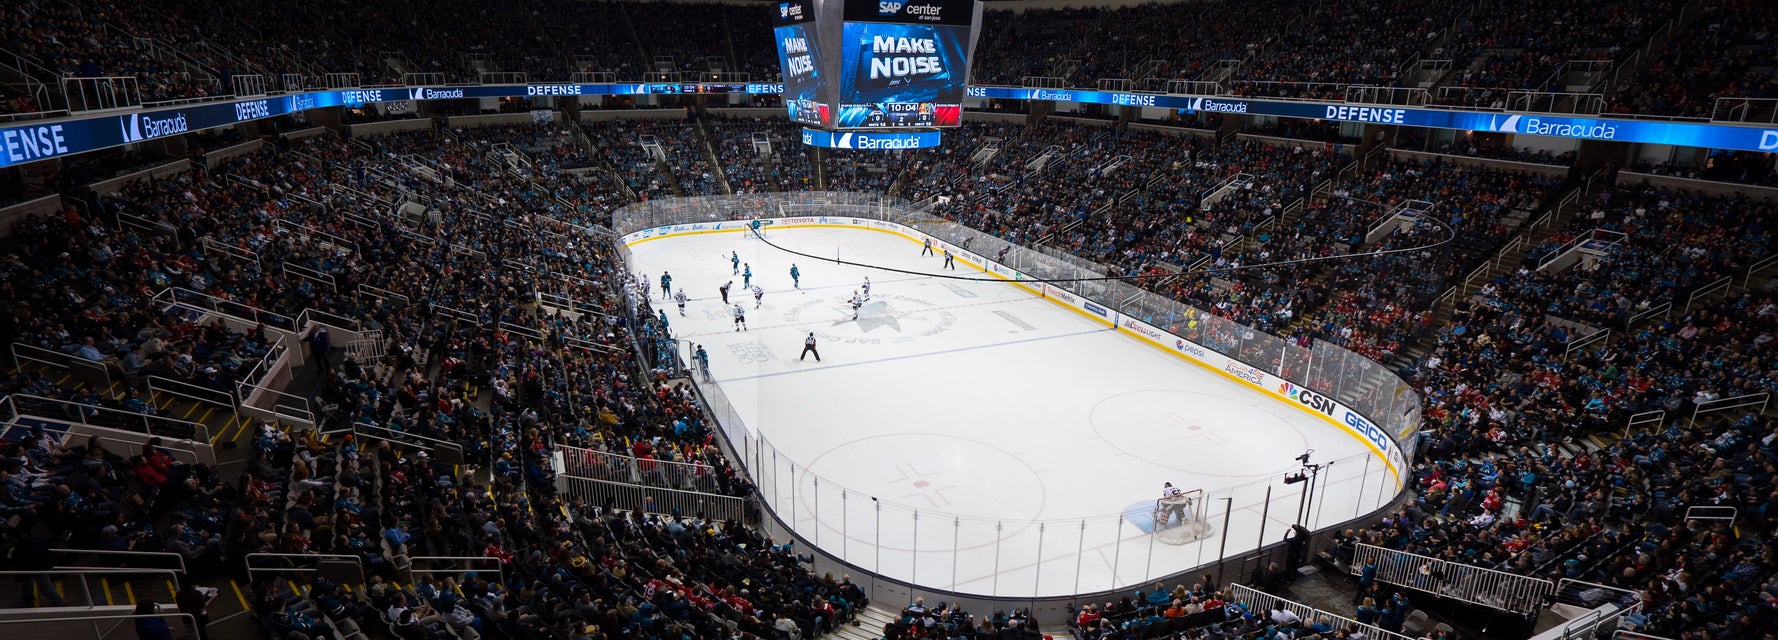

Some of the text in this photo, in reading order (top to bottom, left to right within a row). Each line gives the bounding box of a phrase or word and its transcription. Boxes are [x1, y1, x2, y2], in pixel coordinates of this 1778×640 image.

[879, 1, 942, 15] SAP center
[784, 37, 808, 54] MAKE
[872, 35, 936, 54] MAKE
[787, 54, 814, 78] NOISE
[869, 56, 942, 79] NOISE
[426, 88, 464, 99] Barracuda
[527, 85, 582, 96] DEFENSE
[746, 84, 784, 94] EFENS
[1041, 90, 1072, 101] Barracuda
[341, 90, 382, 104] DEFENSE
[1112, 94, 1155, 107] DEFENSE
[235, 100, 269, 121] DEFENSE
[891, 104, 916, 112] 10:04
[1204, 99, 1248, 113] Barracuda
[1325, 105, 1405, 124] DEFENSE
[143, 112, 188, 139] Barracuda
[1526, 118, 1619, 140] Barracuda
[0, 124, 68, 162] ENSE
[858, 135, 921, 149] Barracuda
[1146, 330, 1161, 340] LIGHT
[1184, 344, 1205, 358] pepsi
[1225, 365, 1263, 387] AMERICA
[1299, 390, 1336, 416] CSN
[1344, 411, 1387, 451] GEICO
